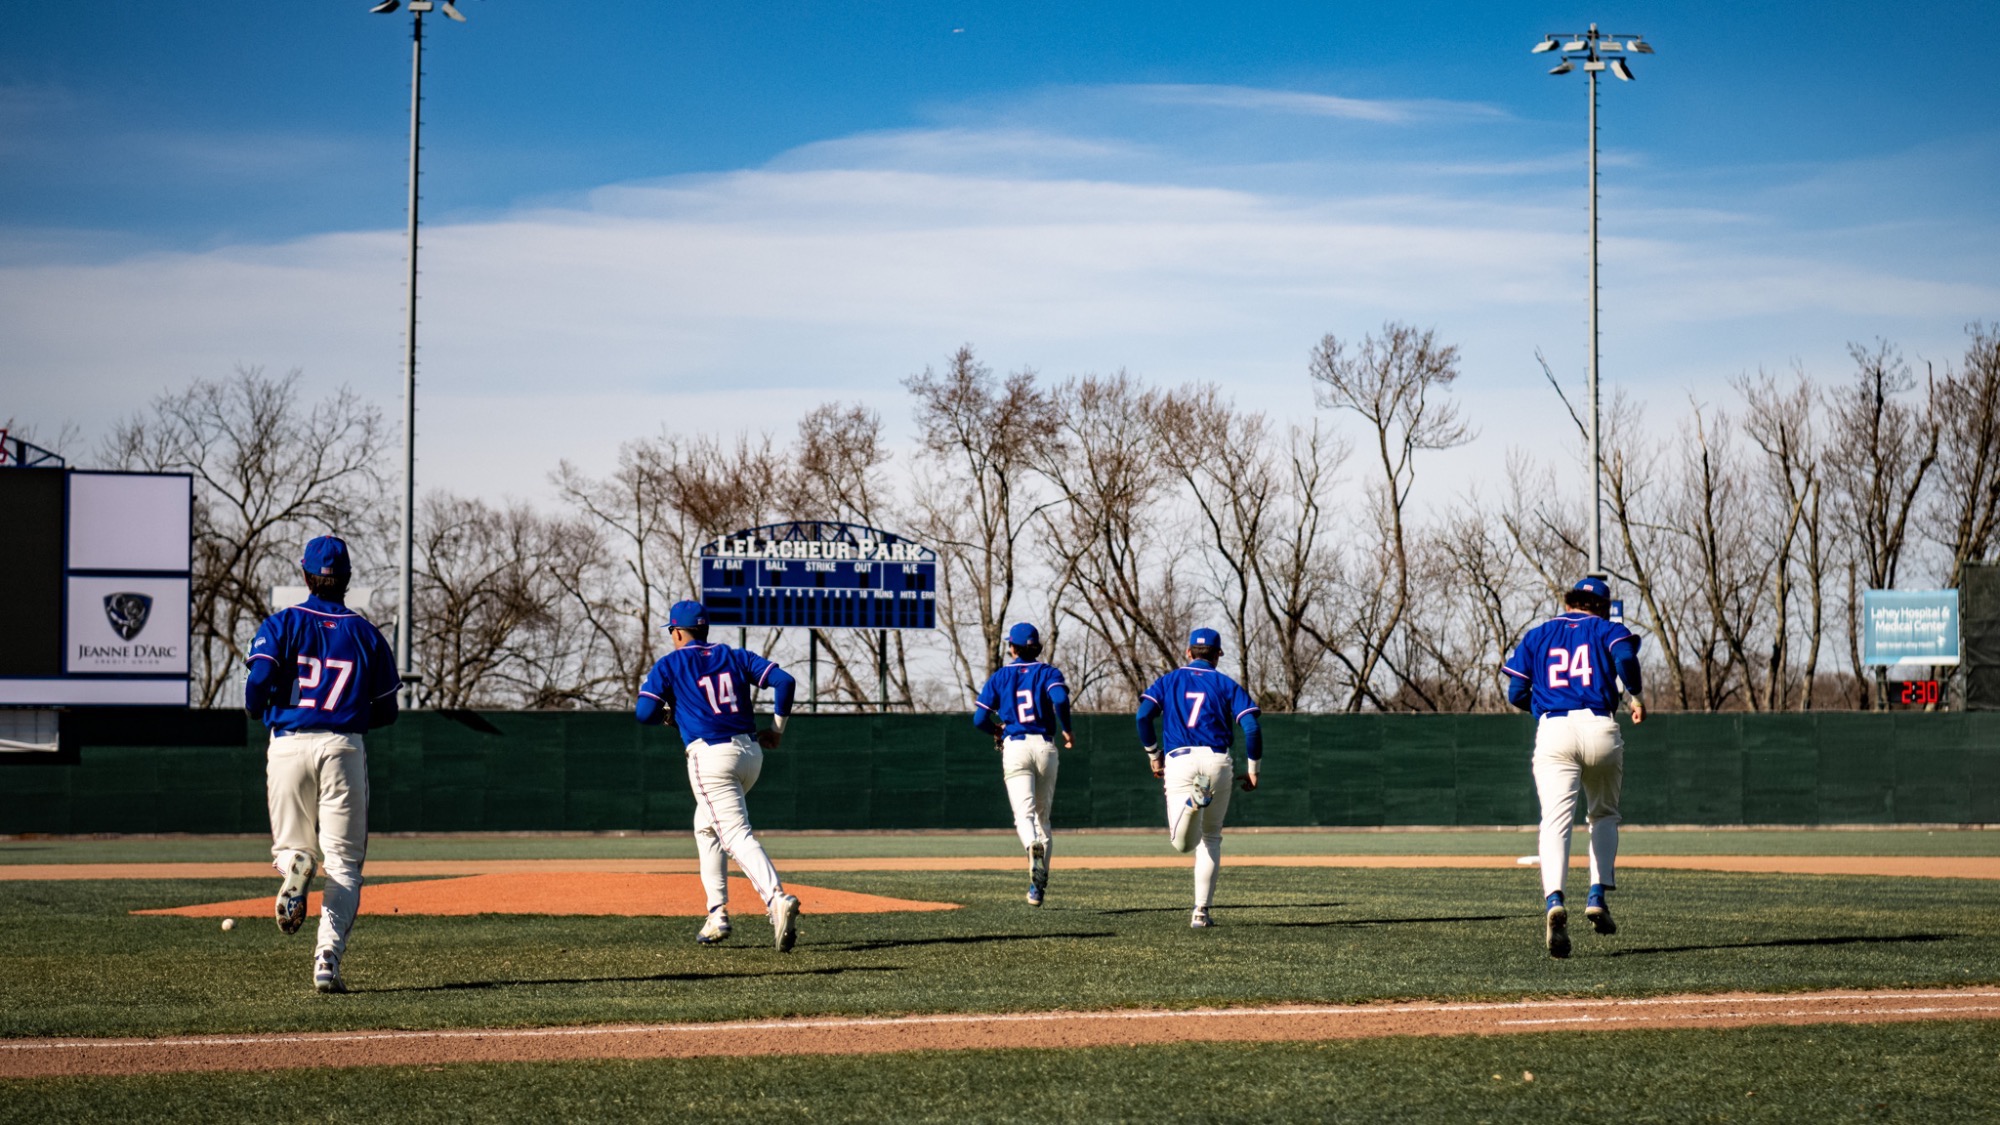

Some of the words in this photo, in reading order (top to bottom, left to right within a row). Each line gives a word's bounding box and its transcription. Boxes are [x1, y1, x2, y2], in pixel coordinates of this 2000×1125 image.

[712, 559, 724, 570] AT
[726, 560, 743, 570] BAT
[765, 561, 788, 571] BALL
[805, 562, 836, 572] STRIKE
[854, 562, 872, 573] OUT
[902, 564, 918, 574] H/E
[748, 588, 753, 596] 1
[759, 588, 764, 597] 2
[771, 588, 776, 597] 3
[785, 588, 791, 597] 4
[797, 588, 802, 597] 5
[809, 588, 814, 597] 6
[824, 589, 829, 598] 7
[835, 589, 840, 598] 8
[846, 590, 851, 599] 9
[859, 590, 867, 599] 10
[874, 590, 894, 599] RUNS
[900, 590, 917, 599] HITS
[1871, 606, 1900, 621] Lahey
[1901, 606, 1940, 620] Hospital
[1941, 605, 1950, 619] &
[1875, 620, 1912, 632] Medical
[1914, 620, 1946, 632] Center
[1548, 644, 1592, 688] 24
[290, 654, 353, 711] 27
[697, 672, 739, 715] 14
[1901, 681, 1938, 704] 2:30
[1016, 690, 1036, 723] 2
[1185, 692, 1205, 728] 7
